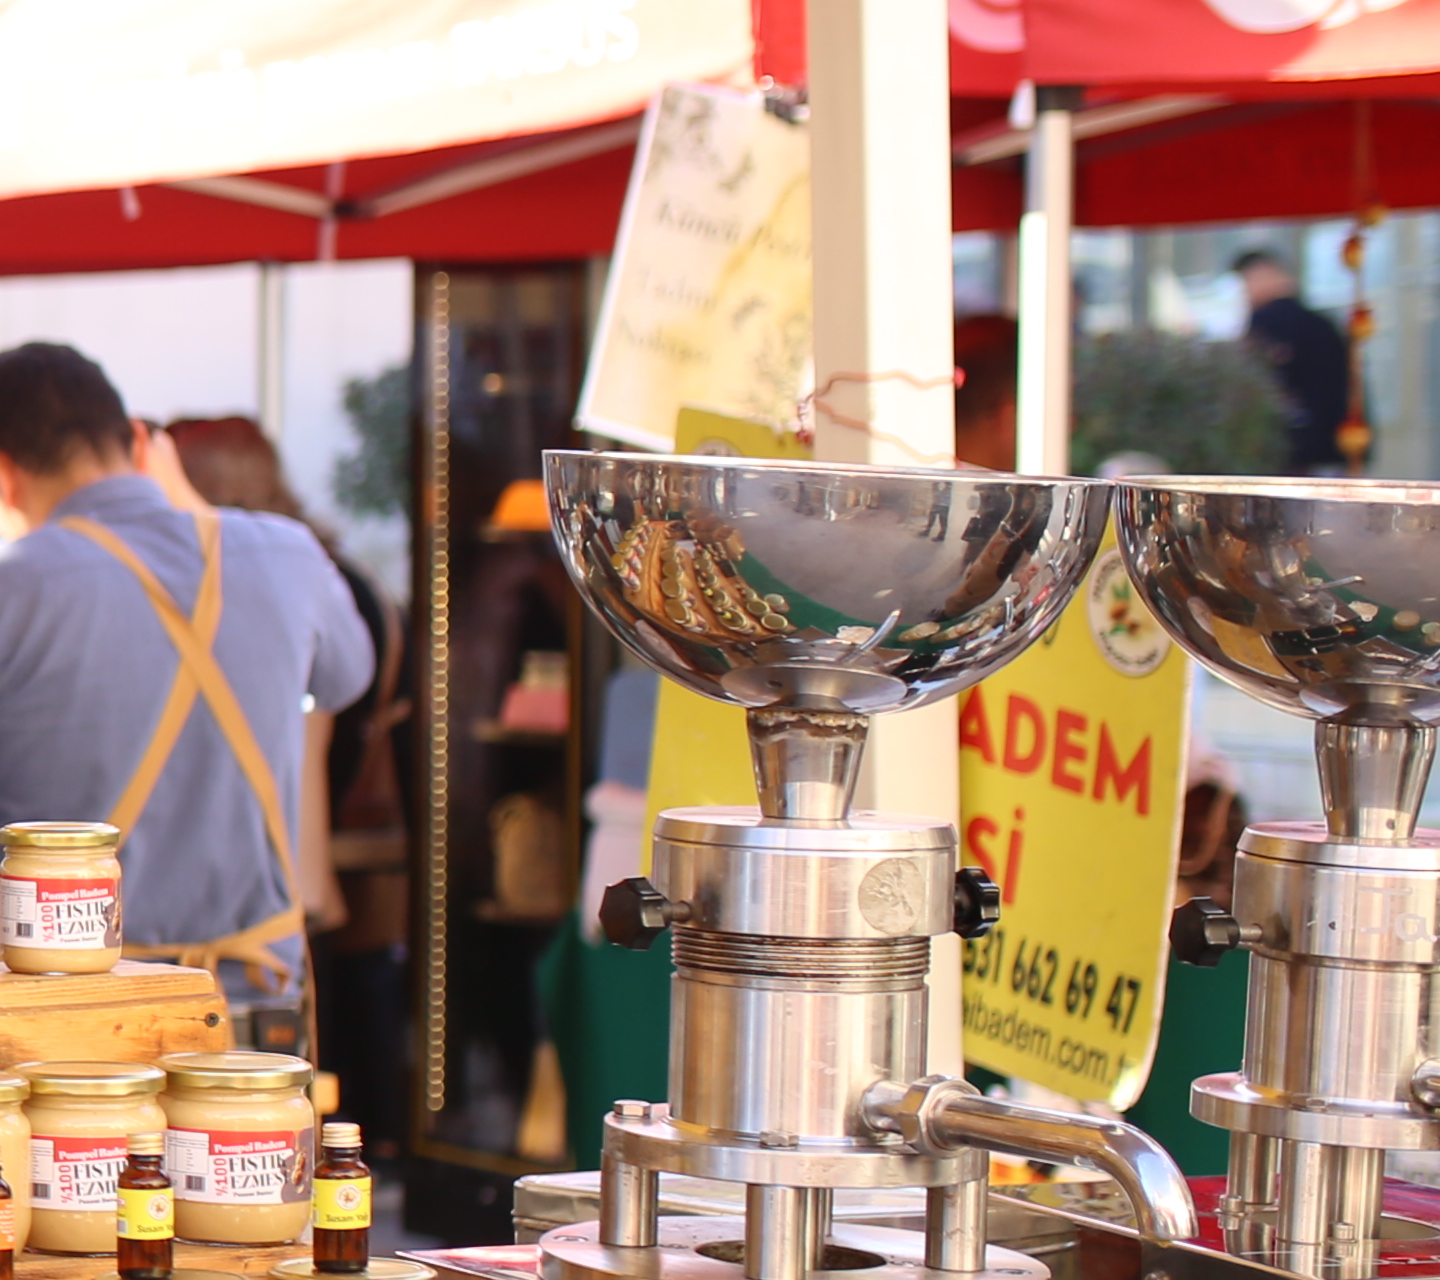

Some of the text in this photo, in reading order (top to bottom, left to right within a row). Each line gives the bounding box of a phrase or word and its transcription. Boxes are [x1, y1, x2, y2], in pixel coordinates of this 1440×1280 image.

[1012, 938, 1060, 1006] 662
[1065, 956, 1100, 1019] 69
[1105, 974, 1142, 1035] 47
